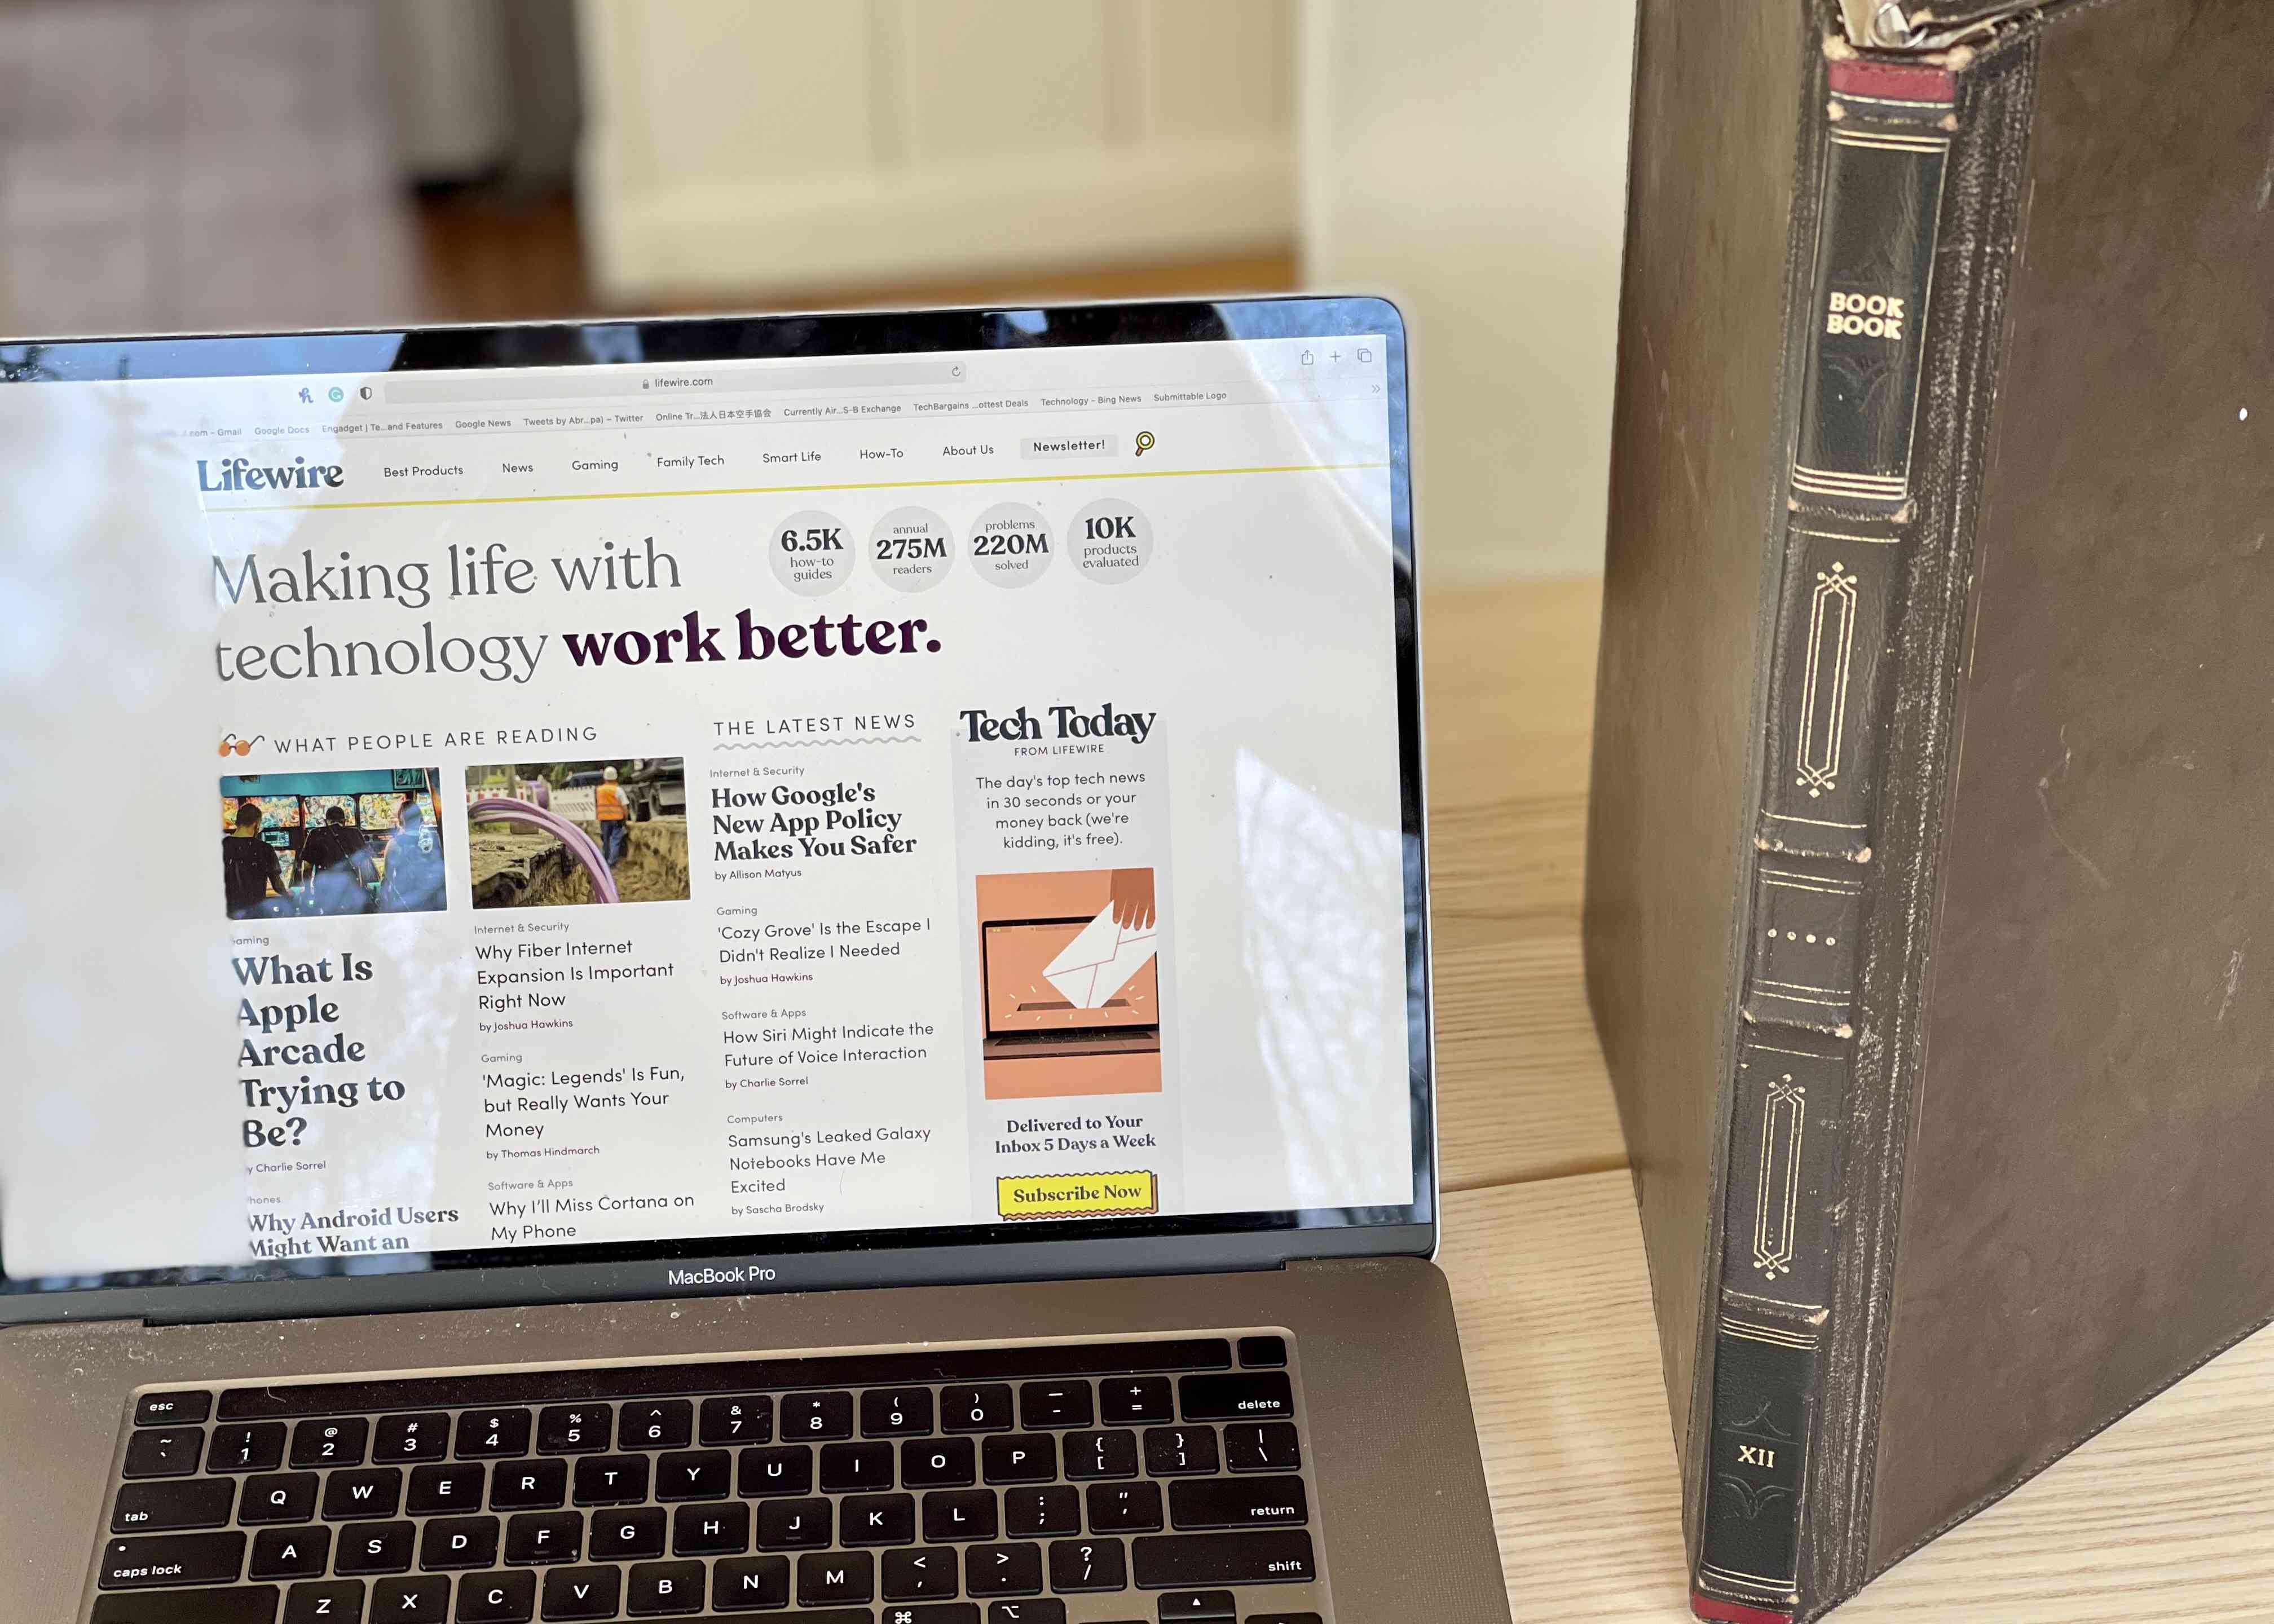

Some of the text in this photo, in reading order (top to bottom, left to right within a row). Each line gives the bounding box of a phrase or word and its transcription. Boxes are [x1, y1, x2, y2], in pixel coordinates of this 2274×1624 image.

[1830, 292, 1904, 318] BOOK
[1827, 314, 1902, 339] BOOK
[655, 378, 713, 387] lifewire.com
[1041, 397, 1088, 406] Technology
[1098, 396, 1116, 405] Bing
[1154, 392, 1204, 401] Submittable
[784, 407, 822, 416] Currently
[861, 405, 901, 413] Exchange
[914, 402, 969, 411] TechBargains
[456, 420, 485, 429] Google
[556, 417, 566, 426] by
[255, 426, 285, 435] Google
[323, 425, 363, 434] Engadget
[943, 445, 994, 456] About Us
[1034, 440, 1104, 451] Newsletter!
[763, 451, 821, 462] Smart Life
[860, 448, 904, 459] How-To
[503, 464, 534, 473] News
[572, 460, 618, 471] Gaming
[658, 454, 724, 469] Family Tech
[197, 456, 344, 491] Lifewire
[384, 465, 463, 477] Best Products
[893, 523, 928, 534] annual
[986, 520, 1035, 533] problems
[1085, 517, 1136, 539] 10K
[782, 528, 844, 551] 6.5K
[973, 533, 1049, 555] 220M
[876, 538, 947, 559] 275M
[1084, 544, 1137, 559] products
[791, 557, 834, 567] how-to
[995, 559, 1028, 570] solved
[1083, 555, 1139, 568] evaluated
[212, 537, 681, 608] Making life with
[794, 568, 832, 582] guides
[893, 564, 932, 574] readers
[215, 608, 941, 683] technology work better.
[713, 714, 914, 735] THE LATEST NEWS
[960, 703, 1156, 744] Tech Today
[274, 727, 596, 753] WHAT PEOPLE ARE READING
[1015, 744, 1104, 756] FROM LIFEWIRE
[710, 766, 804, 778] Internet & Security
[976, 772, 1145, 791] The day's top tech news
[712, 782, 875, 807] How Google's
[987, 793, 1136, 809] in 30 seconds or your
[713, 807, 902, 837] New App Policy
[996, 812, 1129, 830] money back (we're
[715, 833, 917, 860] Makes You Safer
[1004, 832, 1122, 850] kidding, it's free).
[715, 870, 801, 882] by Allison Matyus
[475, 922, 569, 934] Internet & Security
[475, 941, 632, 963] Why Fiber Internet
[232, 953, 372, 986] What Is
[478, 963, 673, 988] Expansion Is Important
[479, 993, 565, 1012] Right Now
[238, 994, 340, 1034] Apple
[479, 1019, 573, 1033] by Joshua Hawkins
[238, 1032, 365, 1067] Arcade
[239, 1075, 405, 1114] Trying to
[1007, 1115, 1143, 1132] Delivered to Your
[243, 1117, 307, 1147] Be?
[996, 1133, 1156, 1153] Inbox 5 Days a Week
[1014, 1185, 1142, 1203] Subscribe Now
[732, 1202, 824, 1217] by Sascha Brodsky
[669, 1266, 775, 1286] MacBook Pro
[1239, 1400, 1280, 1409] delete
[1738, 1445, 1774, 1468] XII
[522, 1477, 535, 1489] R
[605, 1472, 618, 1485] T
[352, 1486, 373, 1499] W
[440, 1481, 451, 1494] E
[271, 1491, 285, 1504] Q
[125, 1512, 148, 1521] tab
[1251, 1507, 1294, 1515] return
[114, 1564, 182, 1578] caps lock
[1269, 1561, 1302, 1571] shift
